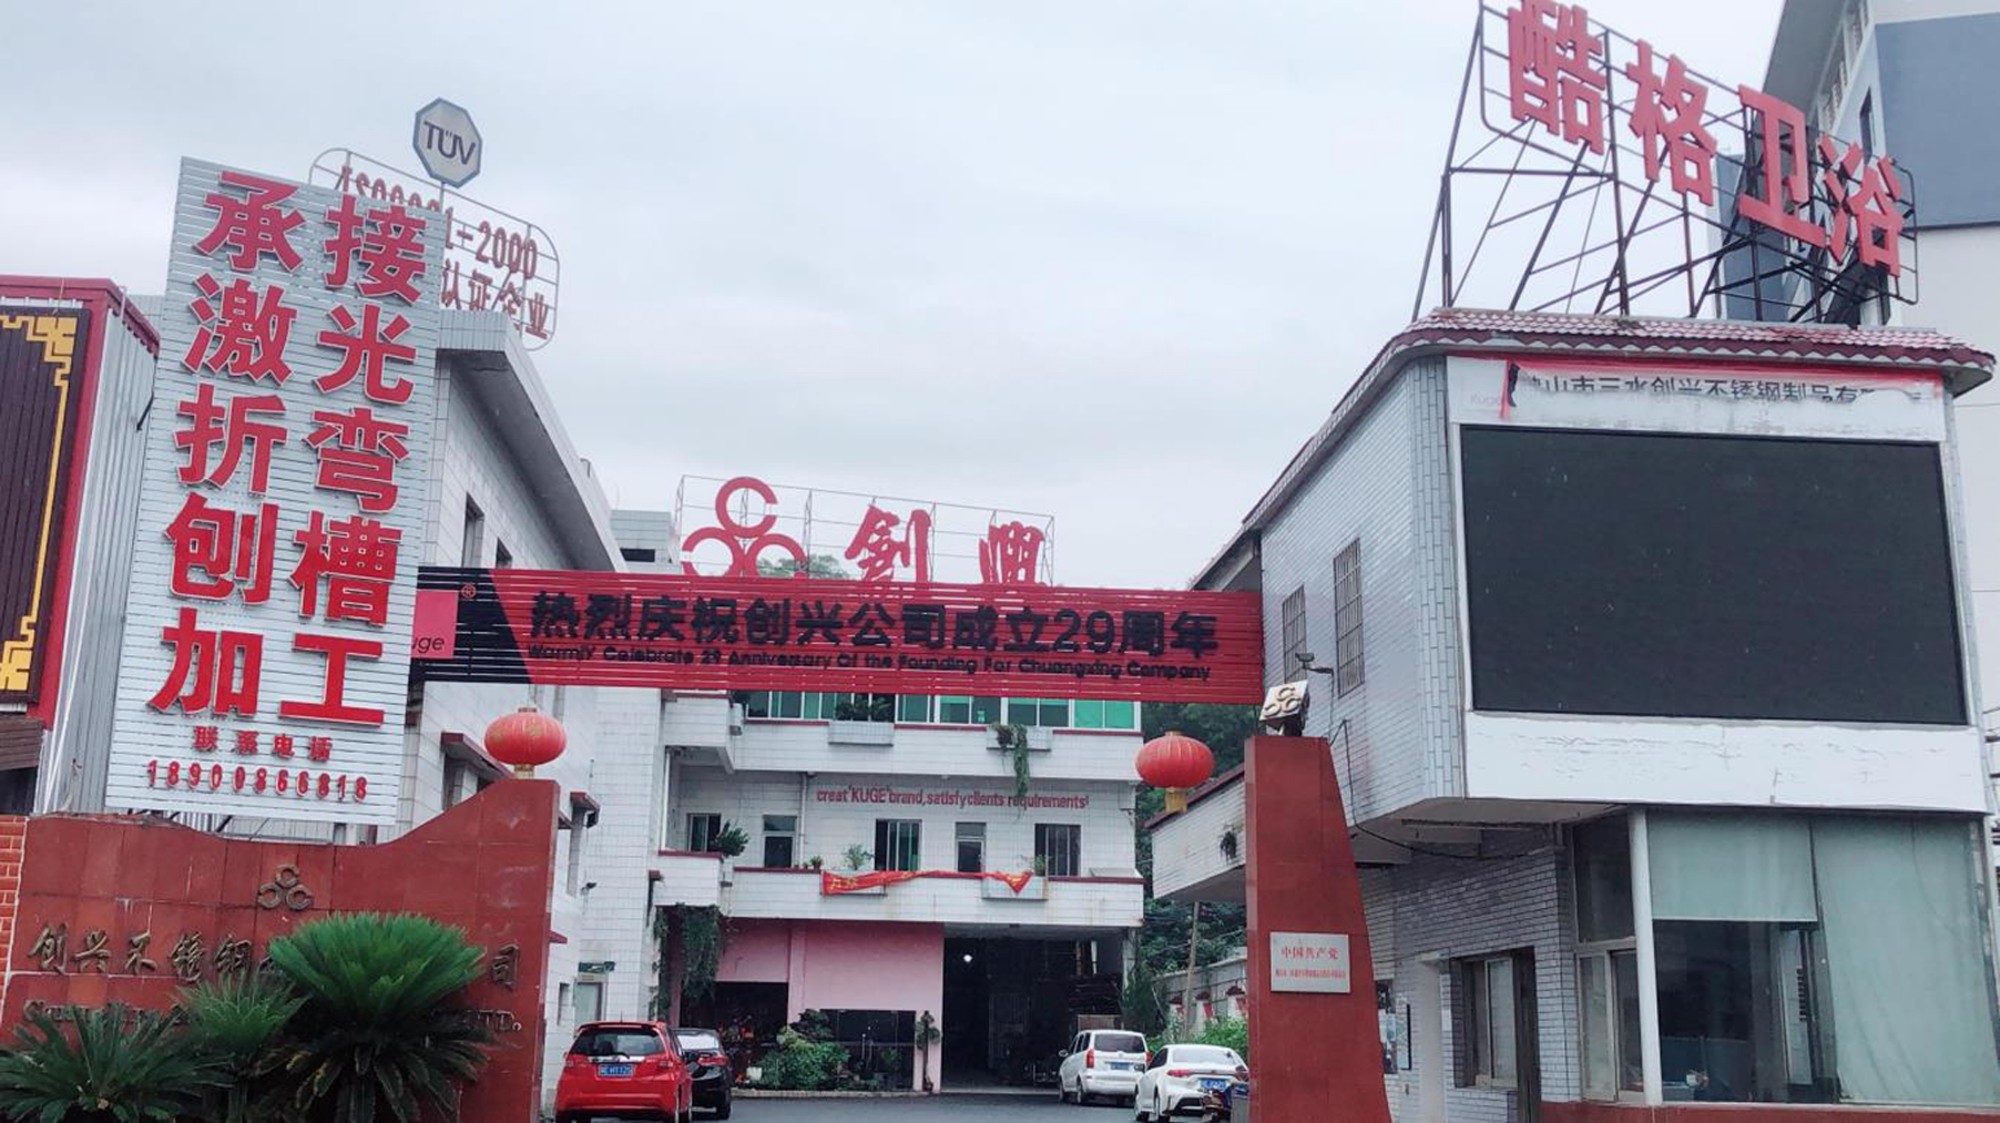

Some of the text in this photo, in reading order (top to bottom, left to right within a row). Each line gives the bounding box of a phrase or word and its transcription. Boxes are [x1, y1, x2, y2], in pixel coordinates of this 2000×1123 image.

[423, 120, 476, 165] TÜV
[1507, 0, 1903, 277] 酷格卫浴
[530, 590, 1218, 659] 热烈庆祝创兴公司成立29周年
[604, 646, 694, 665] Celebrate
[898, 654, 976, 674] Founding
[1127, 660, 1211, 682] Company
[148, 759, 368, 803] 18900866818
